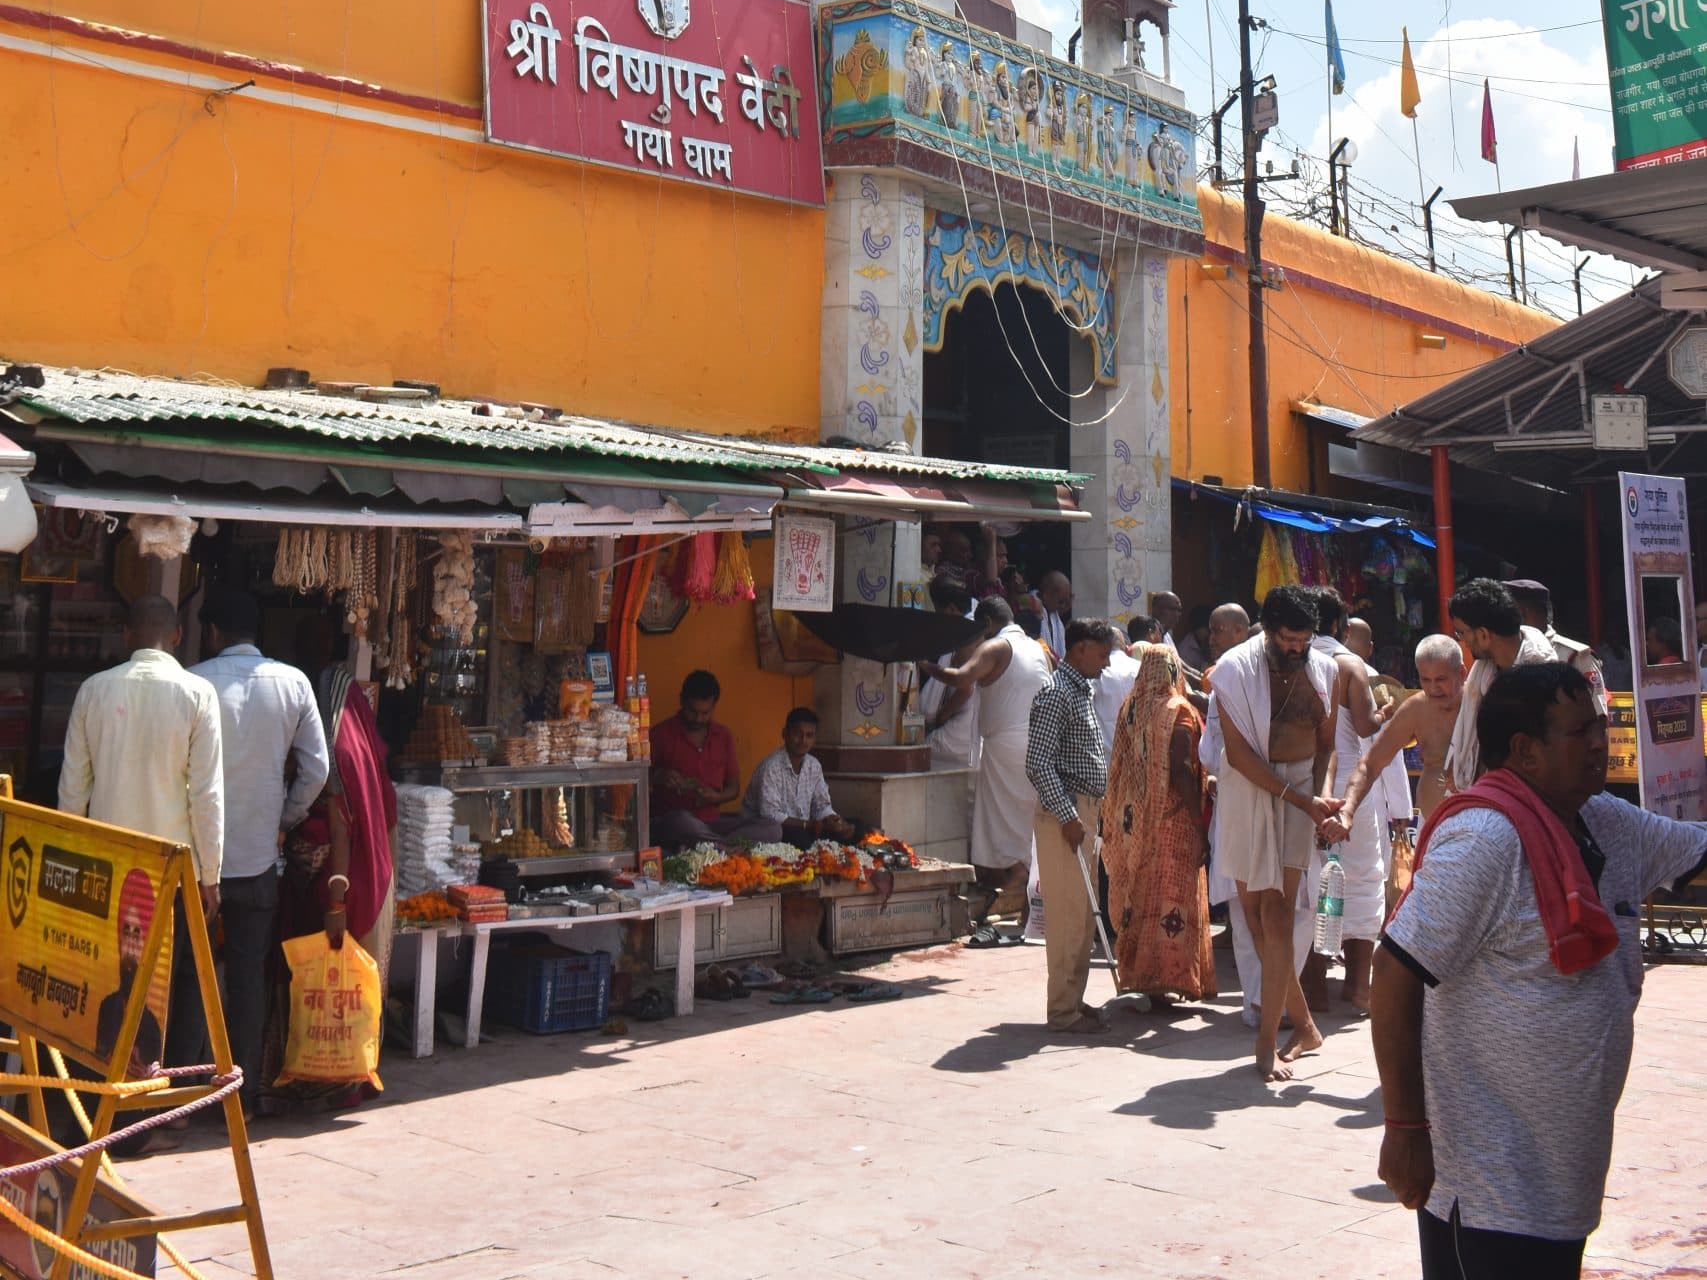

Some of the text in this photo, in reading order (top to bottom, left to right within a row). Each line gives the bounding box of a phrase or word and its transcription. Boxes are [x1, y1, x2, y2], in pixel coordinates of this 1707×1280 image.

[506, 1, 803, 140] श्री विष्णुपद वेदी
[620, 119, 674, 170] गया
[68, 934, 92, 957] BARS
